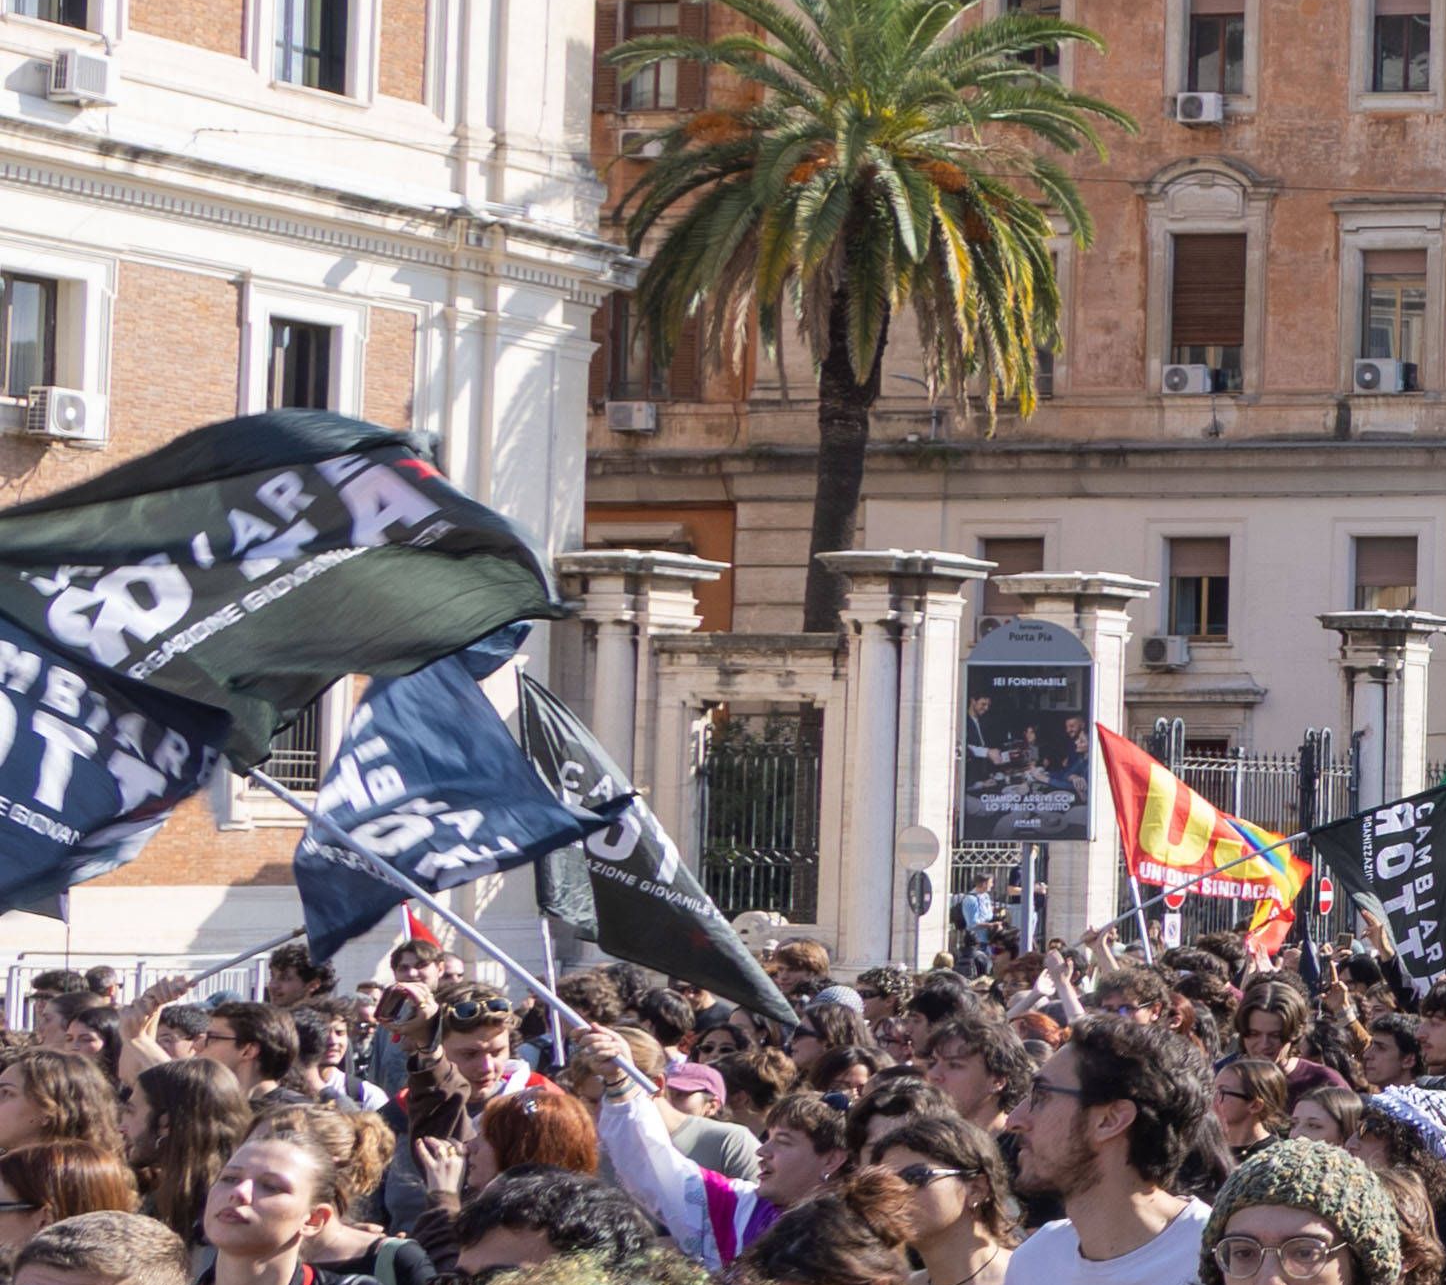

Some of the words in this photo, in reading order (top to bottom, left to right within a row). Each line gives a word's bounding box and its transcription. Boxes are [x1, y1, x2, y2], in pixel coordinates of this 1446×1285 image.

[1009, 632, 1034, 642] Porta
[1038, 632, 1053, 642] Pia
[1008, 677, 1067, 687] FORMIDABILE
[981, 794, 1021, 803] QUANDO
[1024, 794, 1052, 803] ARRIVI
[1054, 794, 1075, 803] CON
[985, 803, 999, 812] LO
